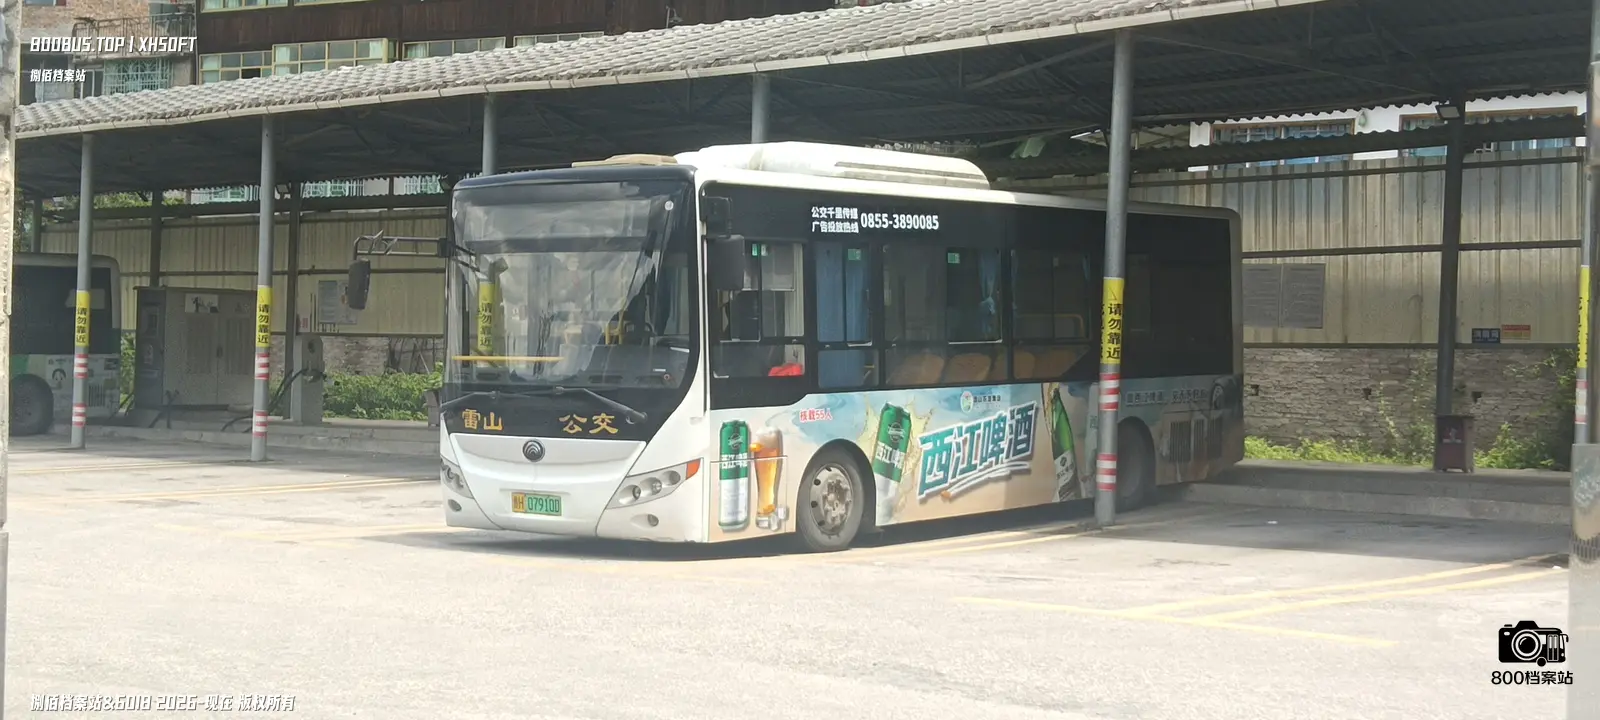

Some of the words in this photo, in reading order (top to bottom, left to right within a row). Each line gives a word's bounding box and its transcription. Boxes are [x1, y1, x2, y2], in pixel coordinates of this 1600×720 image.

[860, 212, 940, 231] 0855-3890085
[76, 307, 88, 343] 请勿靠近
[257, 303, 270, 344] 请勿靠近
[1106, 303, 1123, 360] 请勿靠近
[461, 408, 504, 431] 雷山
[559, 412, 619, 434] 公交
[919, 402, 1036, 499] 西江啤酒
